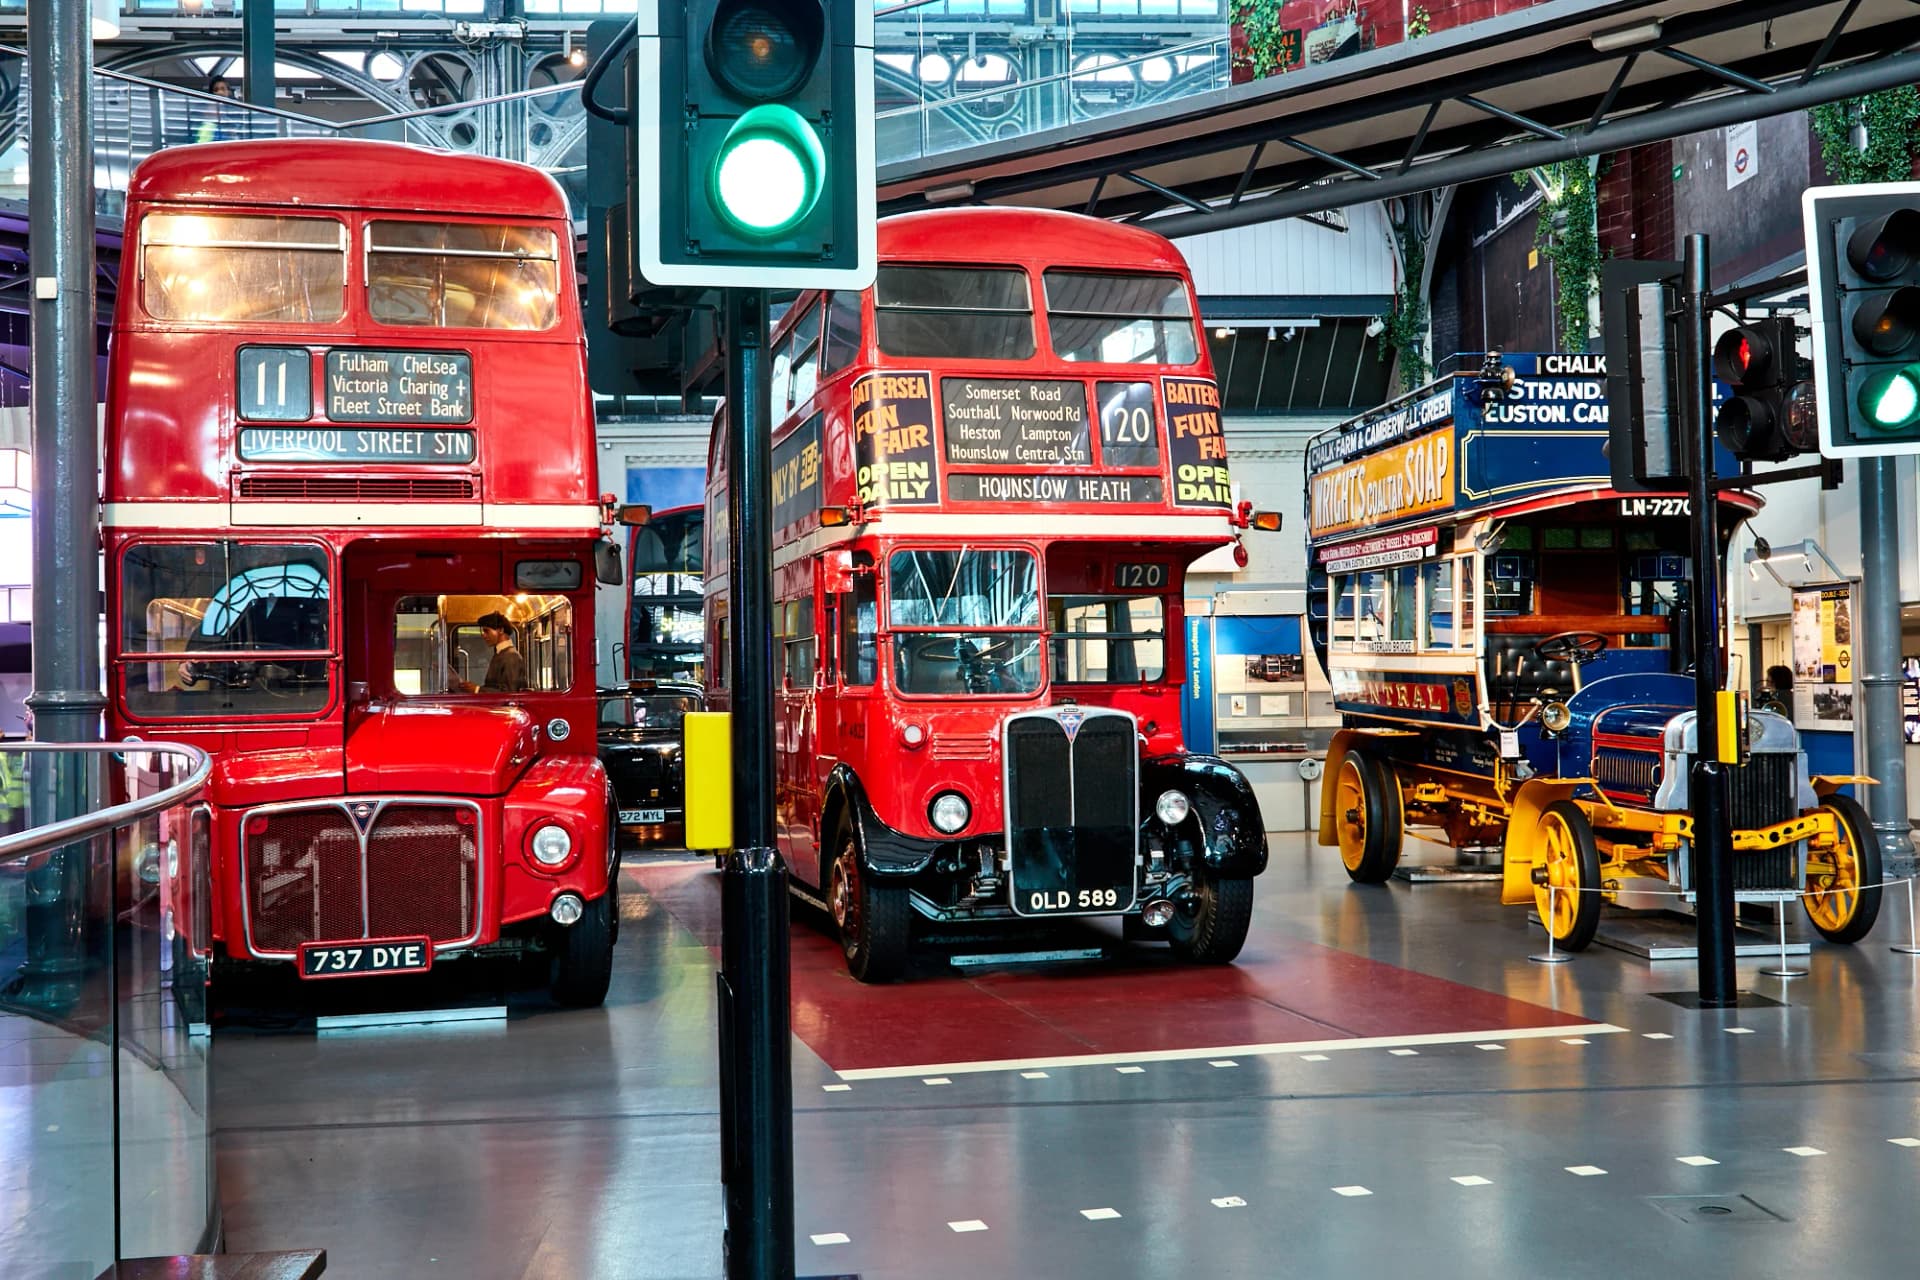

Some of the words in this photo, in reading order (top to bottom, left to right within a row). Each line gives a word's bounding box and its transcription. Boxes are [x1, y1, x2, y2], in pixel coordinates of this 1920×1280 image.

[339, 354, 388, 373] Fulham
[403, 356, 457, 375] Chelsea
[1545, 356, 1606, 373] CHALK
[257, 361, 286, 406] 11
[333, 375, 388, 394] Victoria
[400, 377, 449, 399] Charing
[853, 376, 928, 411] BATTERSEA
[966, 384, 1021, 401] Somerset
[1030, 386, 1061, 401] Road
[333, 397, 370, 414] Fleet
[377, 398, 422, 416] Street
[431, 399, 464, 417] Bank
[948, 404, 1001, 420] Southall
[1011, 406, 1063, 422] Norwood
[1065, 406, 1081, 422] Rd
[855, 404, 900, 443] FUN
[960, 424, 1001, 440] Heston
[1021, 425, 1072, 444] Lampton
[1102, 407, 1150, 443] 120
[1173, 412, 1219, 439] FUN
[242, 430, 347, 452] LIVERPOOL
[357, 431, 424, 454] STREET
[434, 432, 468, 455] STN
[872, 424, 930, 458] FAIR
[951, 444, 1009, 460] Hounslow
[1015, 445, 1061, 461] Central
[1063, 446, 1084, 461] Stn
[771, 463, 788, 507] NLY
[858, 461, 930, 486] OPEN
[1314, 463, 1366, 530] WRIGHT'S
[1405, 436, 1448, 508] SOAP
[857, 481, 931, 504] DAILY
[979, 477, 1067, 500] HOUNSLOW
[1079, 480, 1131, 501] HEATH
[1121, 564, 1161, 587] 120
[1191, 620, 1200, 658] Transport
[1192, 658, 1200, 669] for
[1192, 669, 1201, 699] London
[642, 811, 663, 821] MYL
[1031, 890, 1070, 910] OLD
[1078, 889, 1117, 908] 589
[313, 949, 363, 972] 737
[373, 946, 420, 968] DYE
